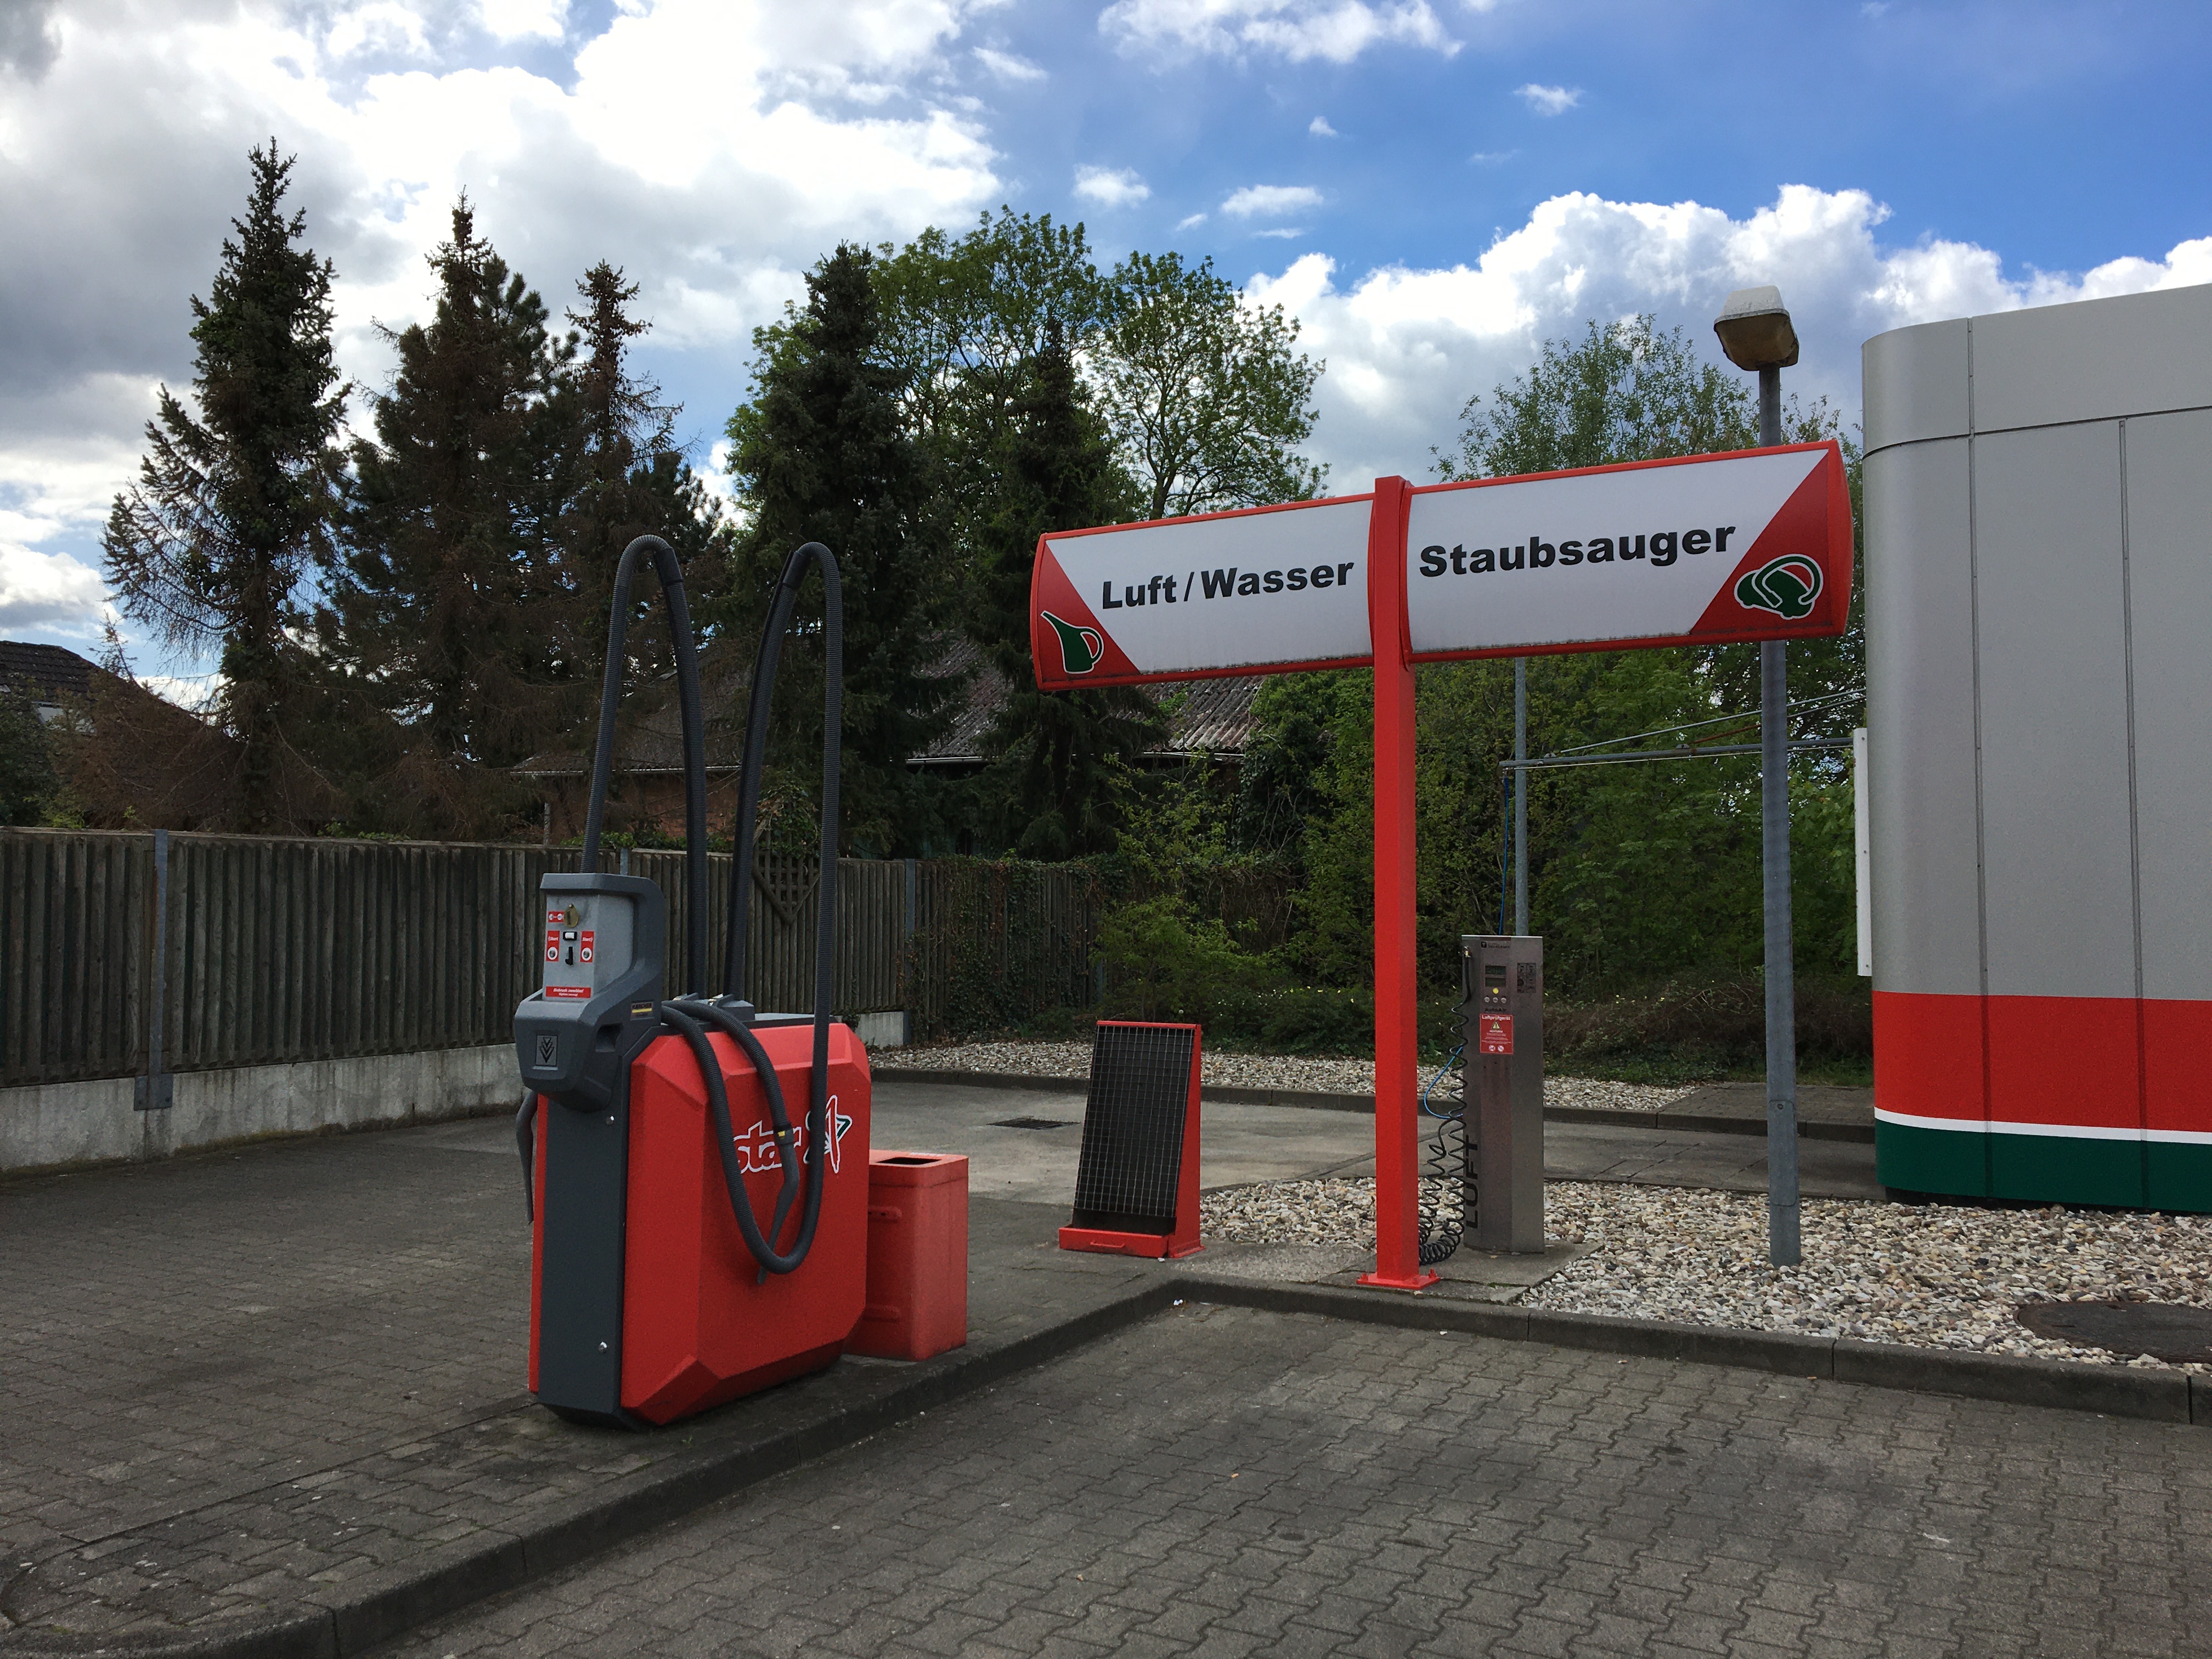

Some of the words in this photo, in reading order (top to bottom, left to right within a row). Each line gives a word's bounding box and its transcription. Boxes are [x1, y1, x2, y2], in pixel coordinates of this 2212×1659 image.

[1419, 526, 1736, 577] Staubsauger
[1102, 574, 1177, 610] Luft
[1200, 562, 1355, 600] Wasser
